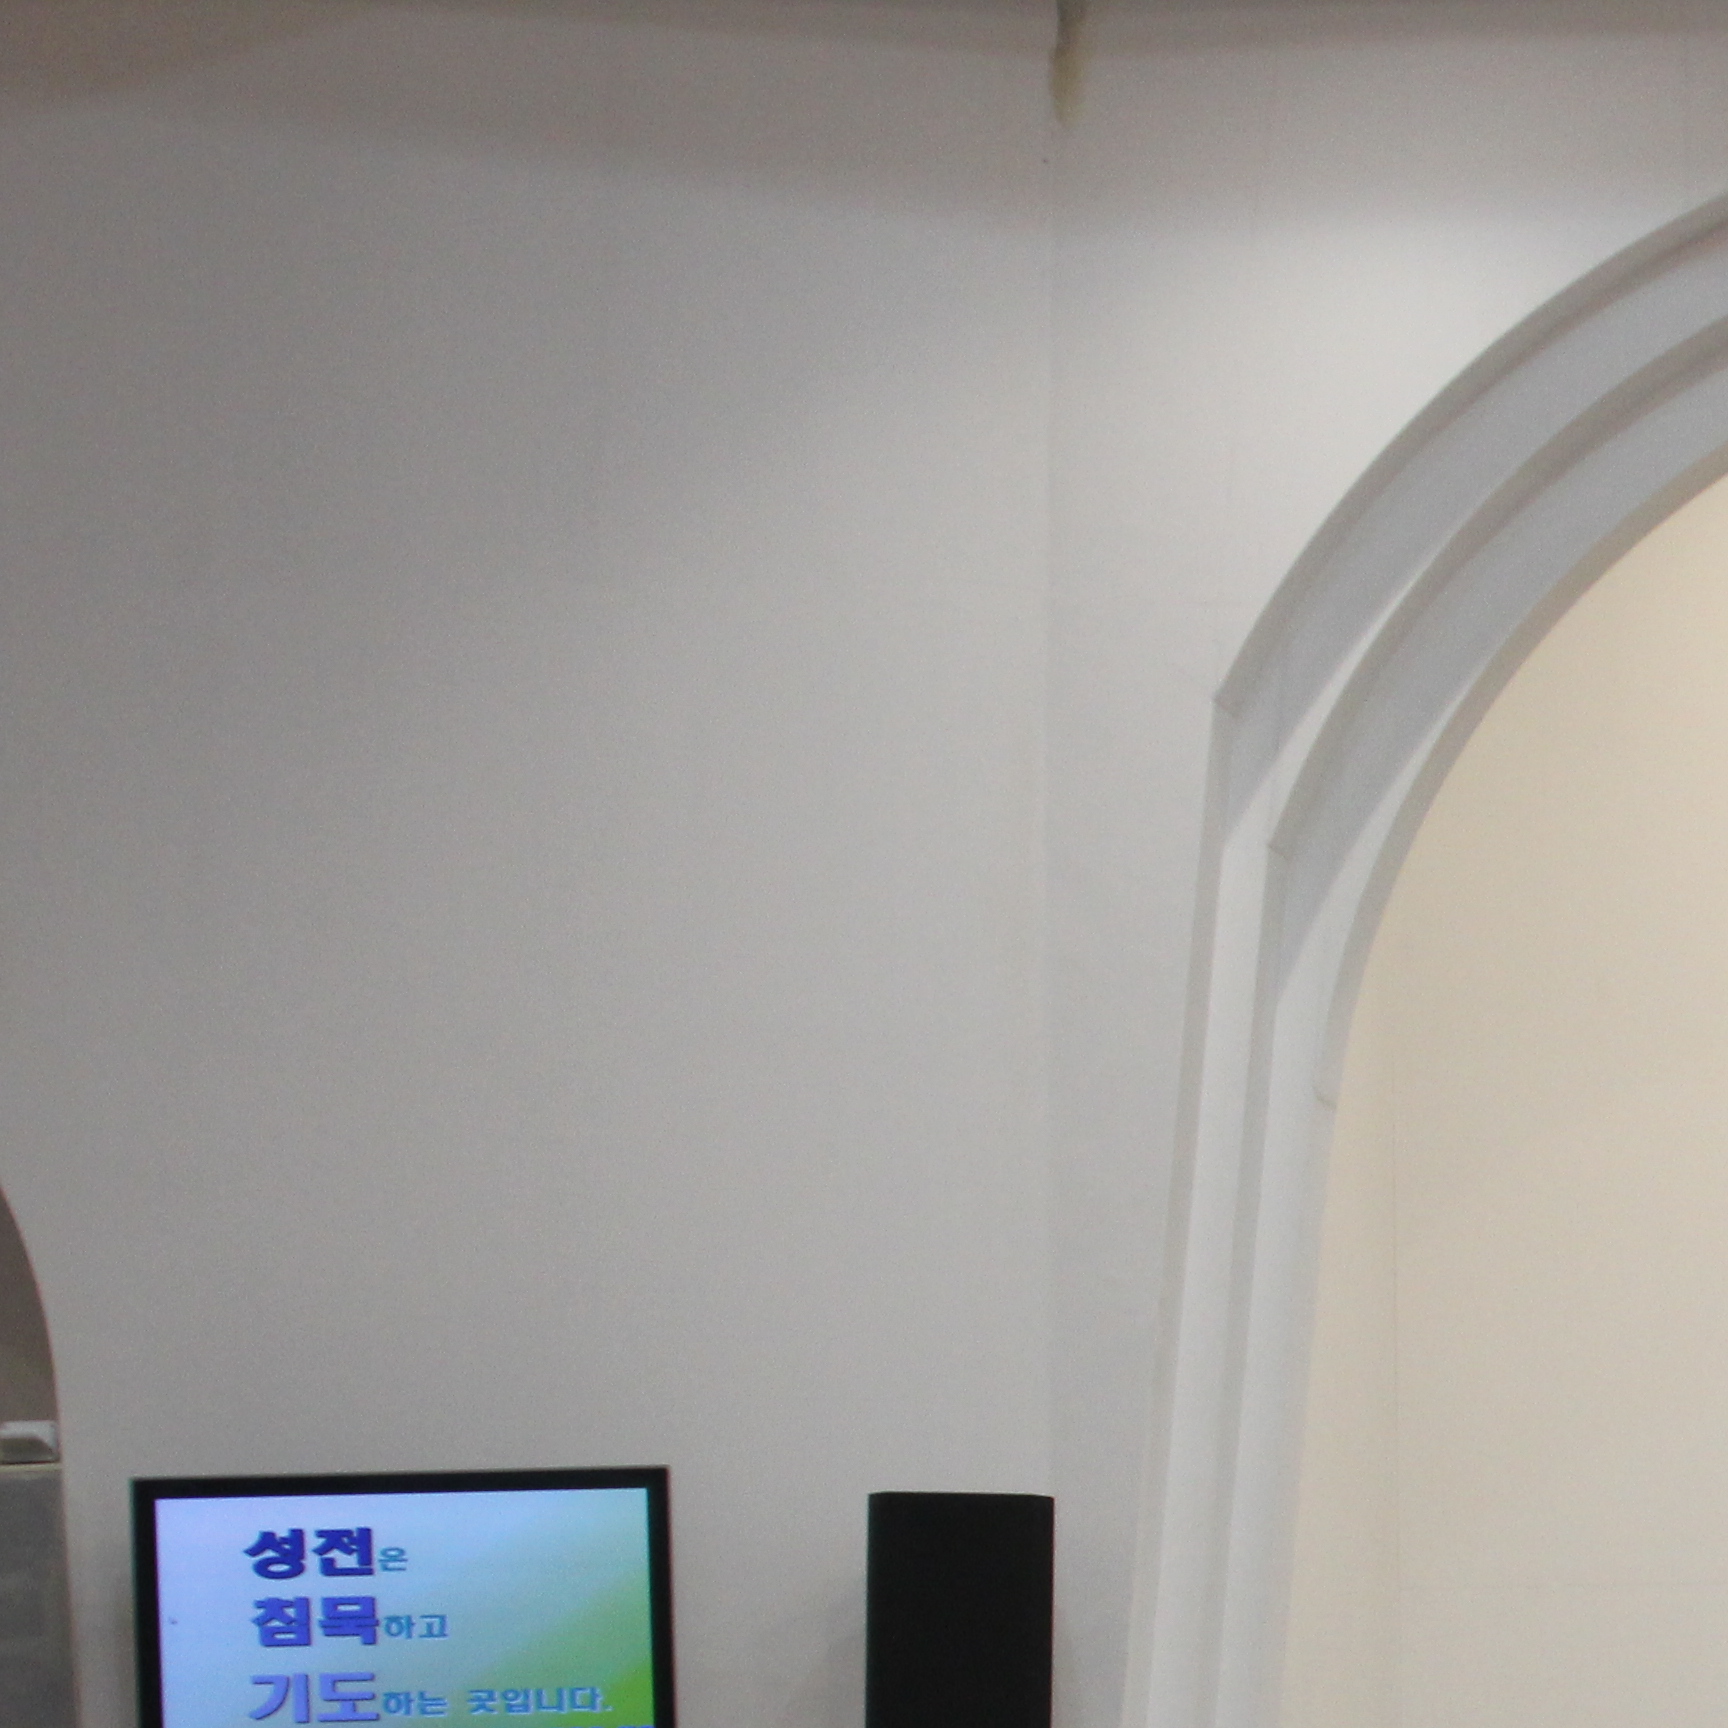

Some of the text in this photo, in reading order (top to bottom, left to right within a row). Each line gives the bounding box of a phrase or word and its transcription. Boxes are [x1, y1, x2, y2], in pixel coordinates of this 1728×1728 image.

[244, 1526, 409, 1580] 성전은
[251, 1596, 449, 1648] 침묵하고
[248, 1671, 612, 1725] 기도하는 곳입니다.
